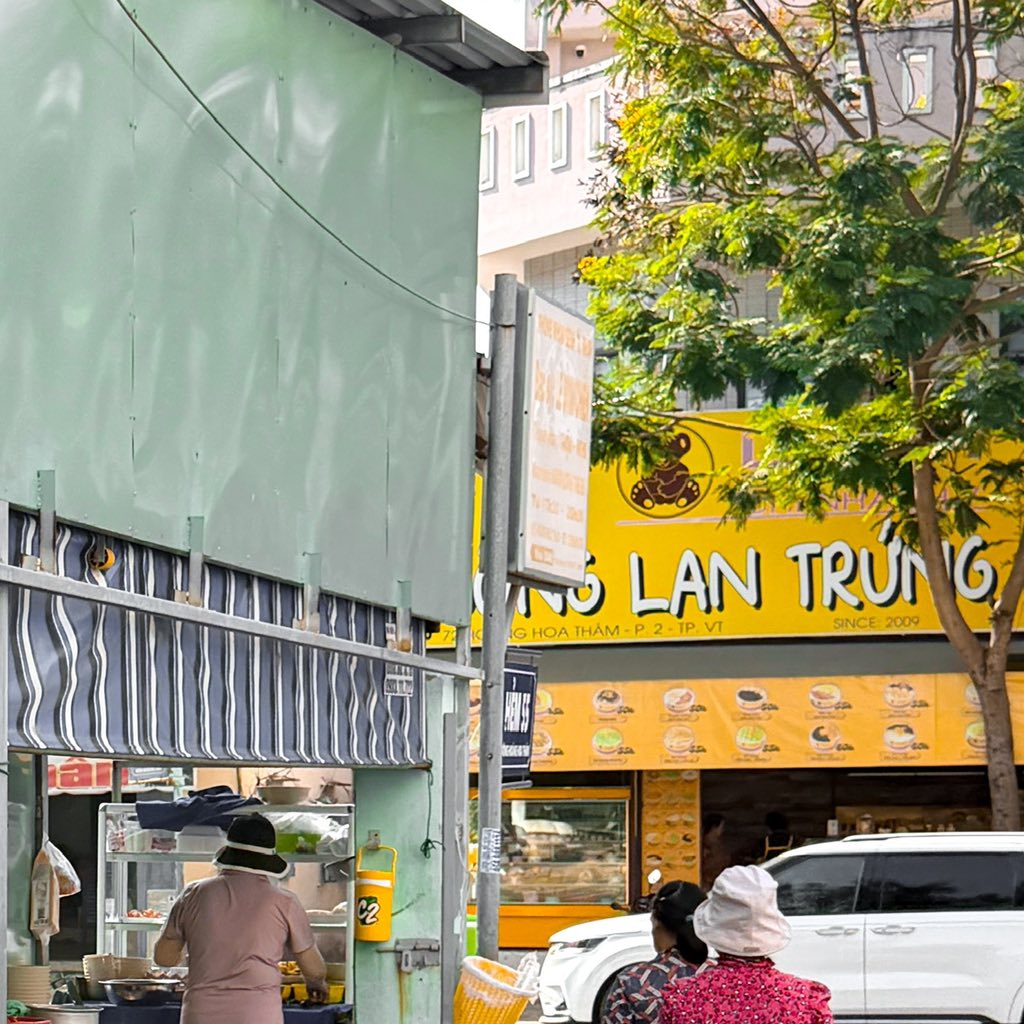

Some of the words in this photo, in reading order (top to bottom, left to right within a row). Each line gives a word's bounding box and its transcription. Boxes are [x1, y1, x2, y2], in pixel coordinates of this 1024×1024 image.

[629, 547, 761, 617] LAN
[532, 627, 569, 639] HOA
[654, 623, 663, 635] 2
[704, 621, 724, 633] VT
[886, 615, 920, 628] 2009
[358, 899, 381, 925] C2
